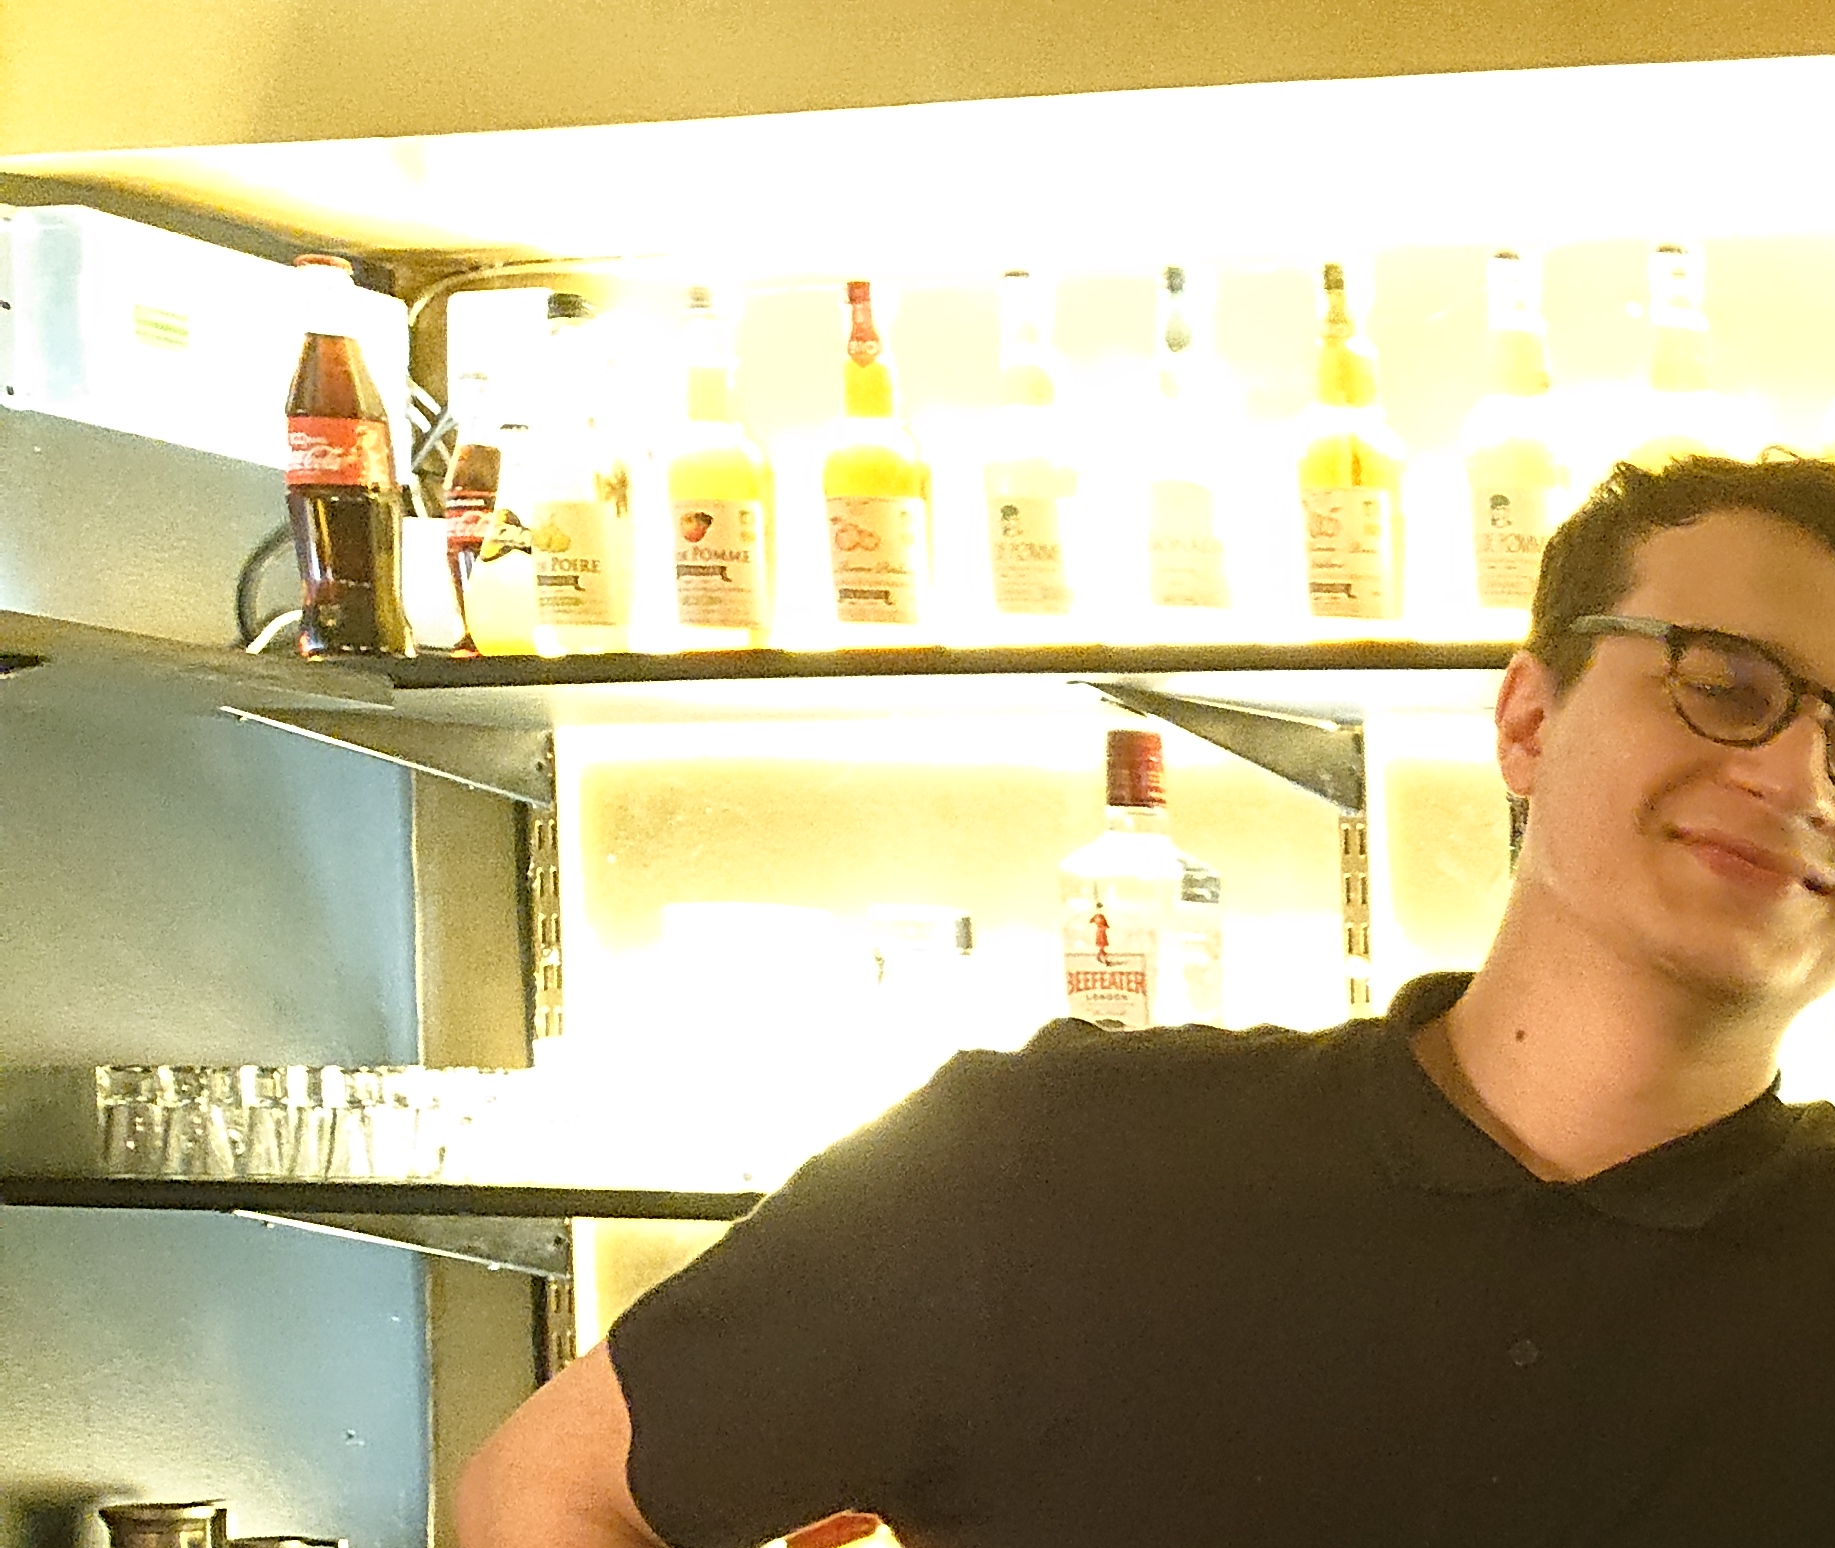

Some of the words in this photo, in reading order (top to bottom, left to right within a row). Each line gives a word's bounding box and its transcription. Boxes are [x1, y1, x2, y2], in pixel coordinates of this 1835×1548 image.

[691, 545, 751, 563] POMME
[551, 556, 601, 574] POIRE
[1067, 970, 1147, 996] BEEFEATER
